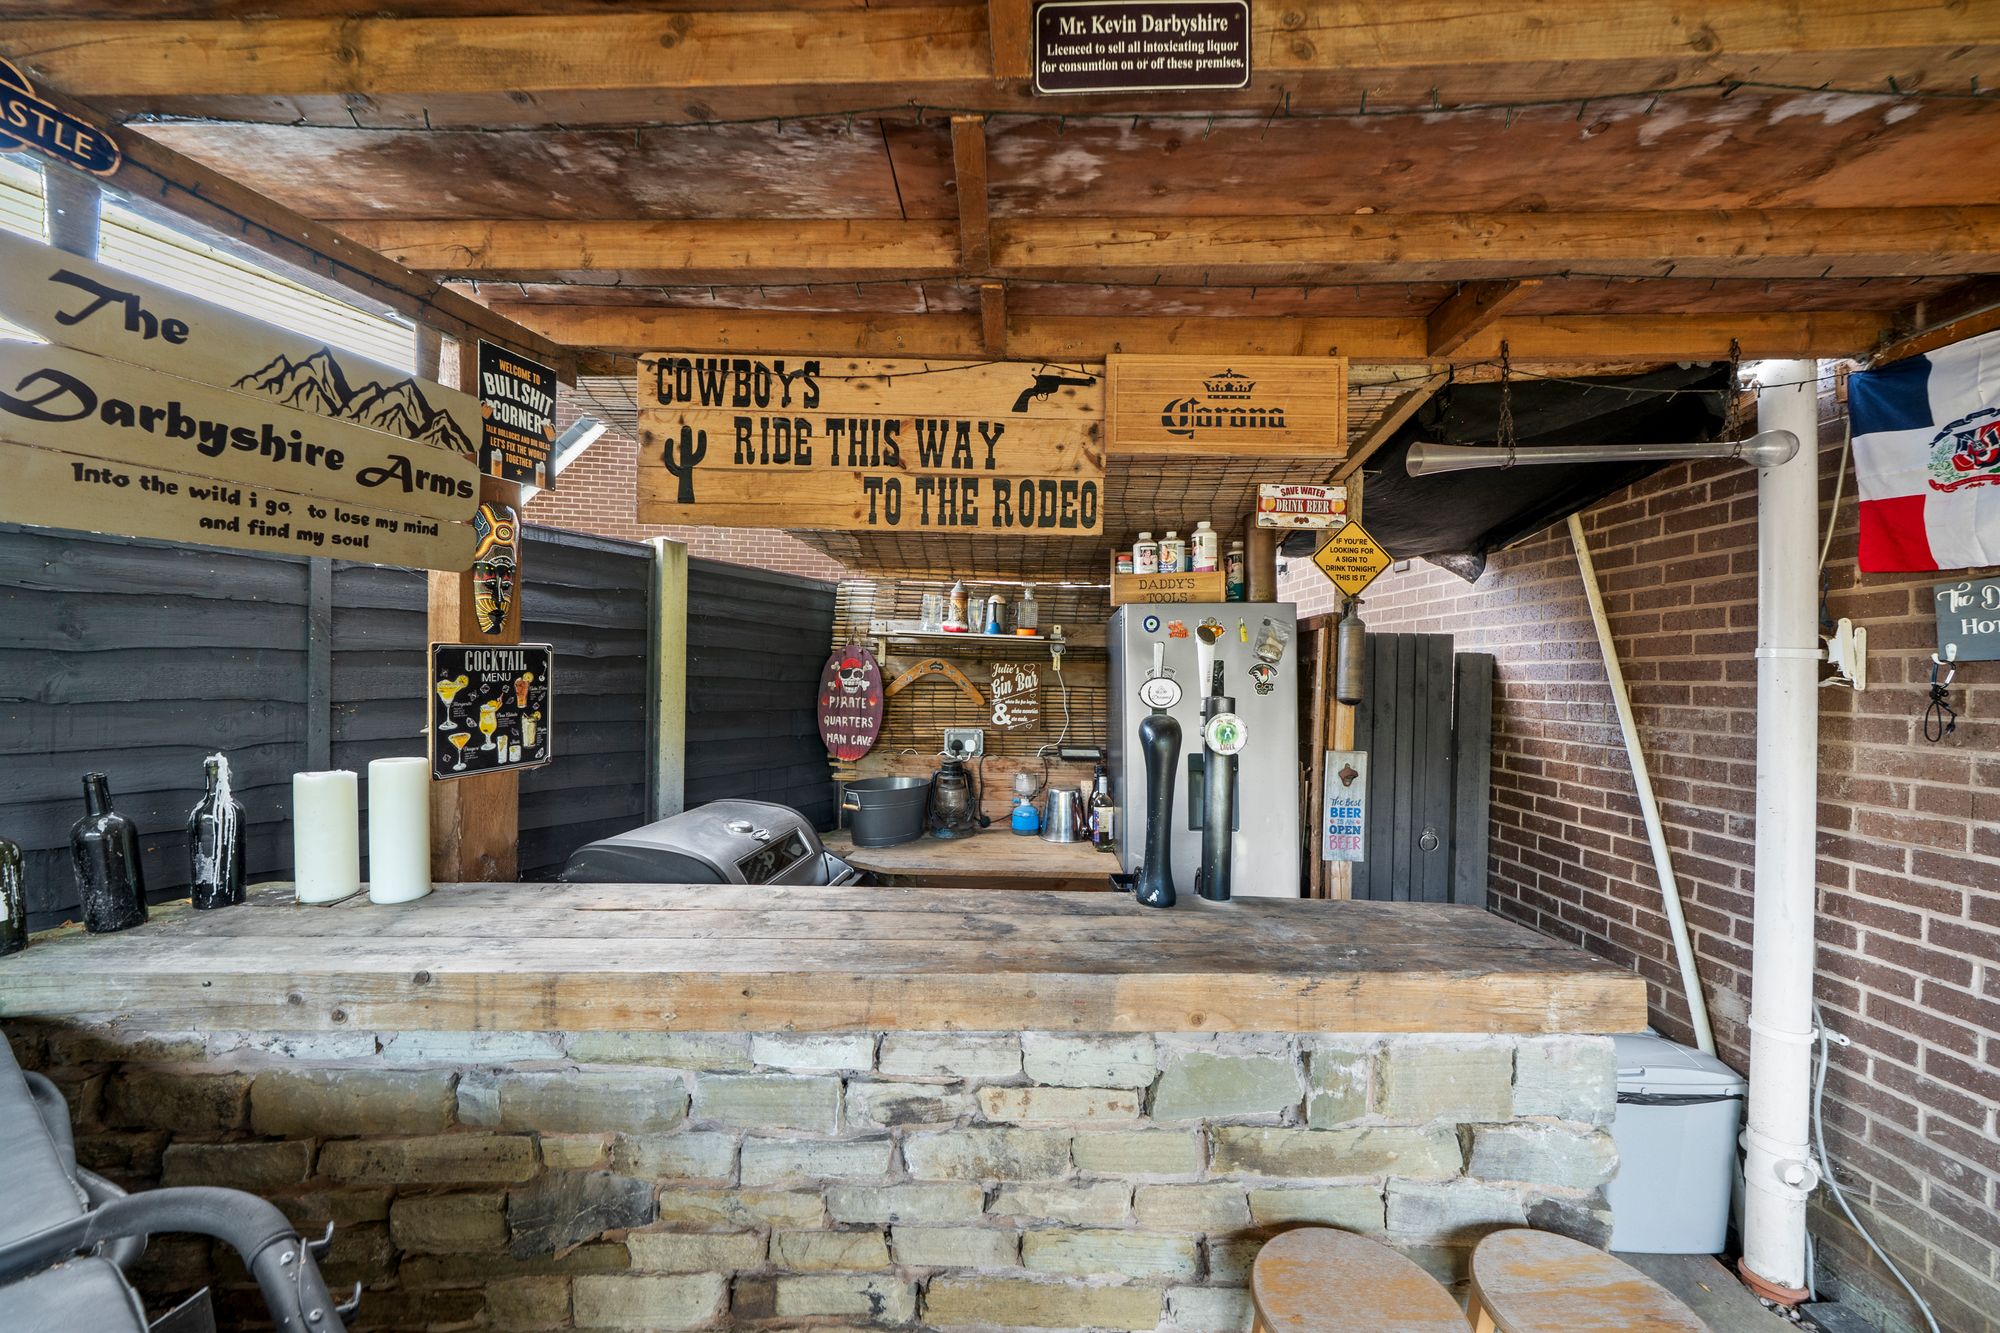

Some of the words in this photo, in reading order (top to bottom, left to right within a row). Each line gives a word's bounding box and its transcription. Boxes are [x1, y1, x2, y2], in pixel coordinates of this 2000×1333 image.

[1058, 16, 1087, 36] Mr.
[1091, 14, 1137, 35] Kevin
[1141, 12, 1229, 36] Darbyshire
[1047, 42, 1092, 56] Licenced
[1095, 43, 1105, 55] to
[1108, 41, 1125, 54] sell
[1128, 40, 1141, 53] all
[1143, 39, 1205, 55] intoxicating
[1207, 39, 1239, 54] liquor
[1041, 60, 1057, 73] for
[1059, 59, 1118, 72] consumtion
[1121, 60, 1134, 71] on
[1137, 59, 1149, 70] or
[1151, 57, 1165, 70] off
[1166, 57, 1193, 70] these
[1195, 55, 1245, 72] premises.
[48, 268, 190, 345] The
[499, 359, 531, 381] WELCOME
[532, 373, 541, 385] TO
[656, 357, 821, 409] COWBOYS
[483, 371, 553, 416] BULLSHIT
[493, 400, 542, 435] CORNER
[1161, 396, 1287, 440] Corona
[0, 367, 345, 471] Darbyshire
[355, 454, 474, 499] Arms
[490, 437, 505, 449] LET'S
[506, 440, 516, 451] FIX
[517, 443, 527, 455] THE
[528, 446, 547, 462] WORLD
[733, 415, 813, 467] RIDE
[825, 418, 901, 467] THIS
[915, 418, 1005, 470] WAY
[505, 453, 533, 469] TOGETHER
[71, 461, 131, 488] Into
[139, 474, 179, 496] the
[189, 485, 241, 506] wild
[249, 491, 258, 508] i
[265, 499, 293, 516] go,
[307, 504, 327, 519] to
[334, 508, 370, 527] lose
[375, 516, 398, 533] my
[403, 519, 439, 537] mind
[1280, 486, 1299, 497] SAVE
[1300, 486, 1326, 498] WATER
[863, 476, 901, 526] TO
[915, 476, 979, 526] THE
[991, 479, 1097, 529] RODEO
[1275, 498, 1305, 513] DRINK
[1306, 499, 1330, 513] BEER
[199, 516, 240, 533] and
[246, 519, 290, 539] find
[296, 528, 325, 546] my
[331, 533, 369, 549] soul
[1335, 537, 1342, 545] IF
[1343, 537, 1368, 546] YOU'RE
[1329, 546, 1359, 554] LOOKING
[1360, 547, 1374, 555] FOR
[1138, 577, 1195, 590] DADDY'S
[1146, 592, 1188, 603] TOOLS
[1936, 582, 1974, 614] The
[464, 650, 527, 672] COCKTAIL
[992, 663, 1019, 677] Julie's
[481, 672, 511, 683] MENU
[991, 675, 1013, 698] Gin
[1015, 671, 1039, 691] Bar
[829, 695, 867, 709] PIRATE
[824, 715, 873, 728] QUARTERS
[992, 703, 1012, 725] &
[826, 733, 846, 746] MAN
[851, 735, 873, 746] CAVE
[1330, 797, 1344, 807] The
[1345, 797, 1361, 807] Best
[1330, 807, 1361, 818] BEER
[1329, 825, 1361, 835] OPEN
[1329, 835, 1361, 850] BEER
